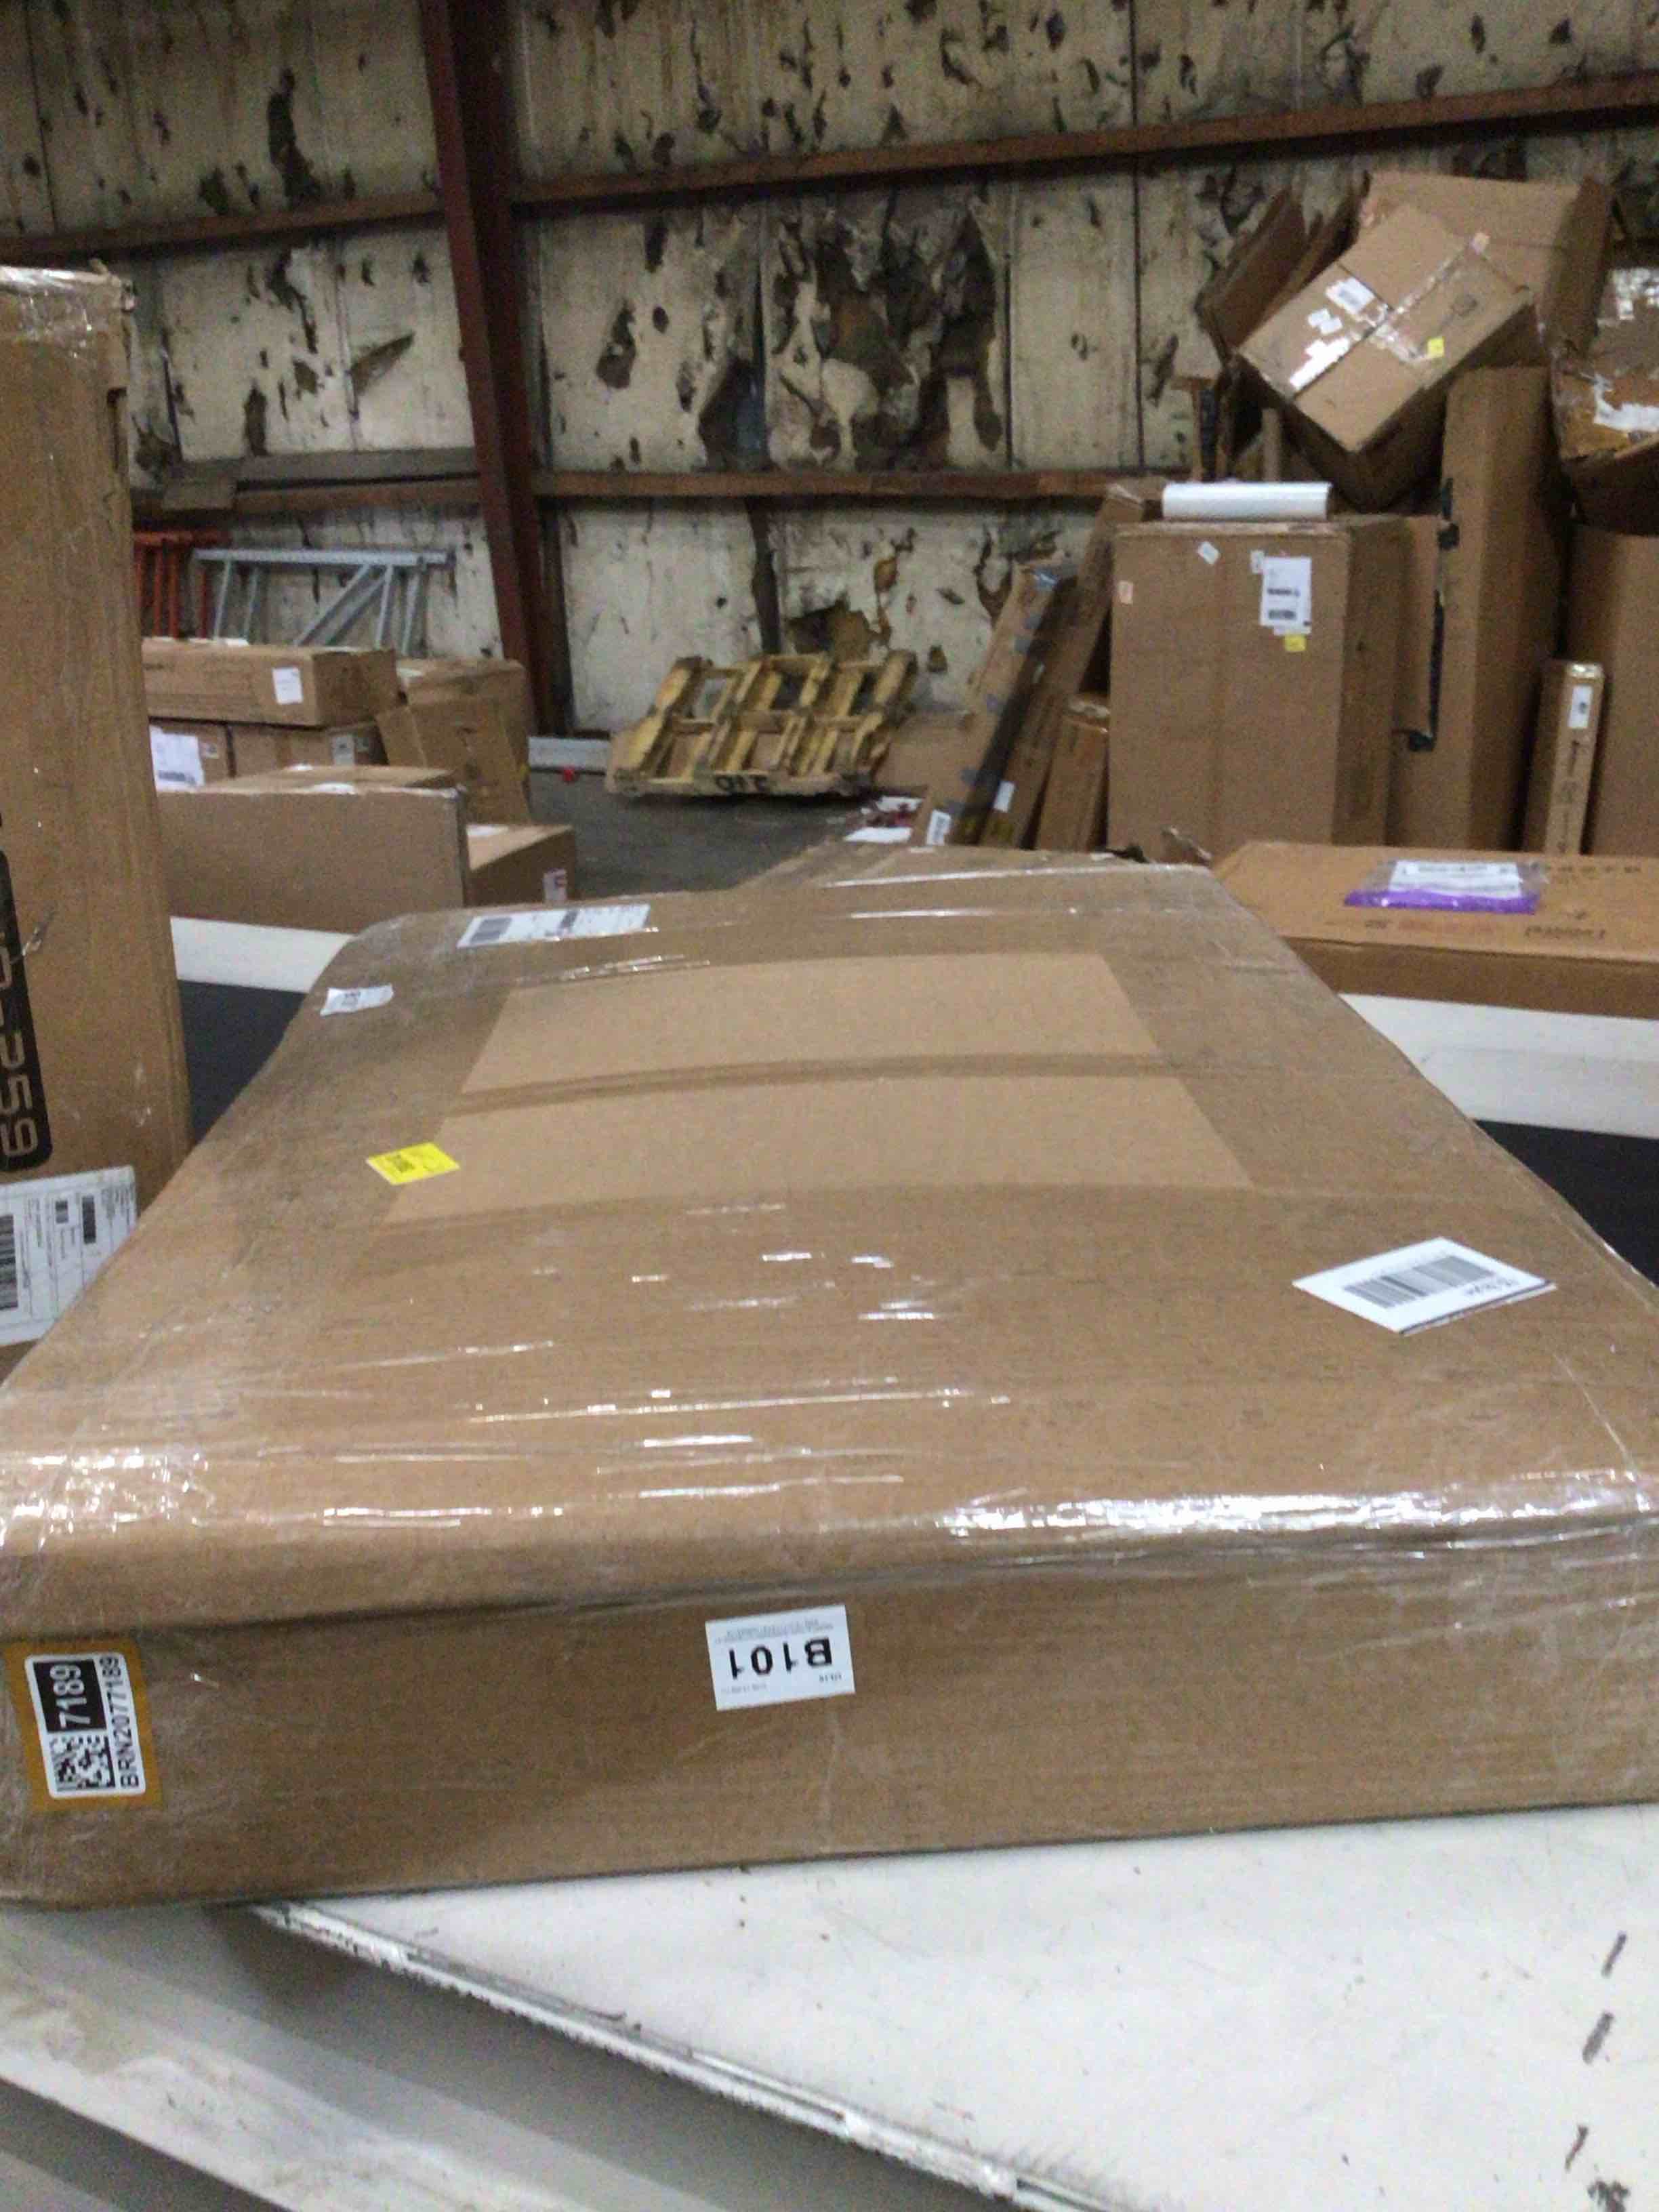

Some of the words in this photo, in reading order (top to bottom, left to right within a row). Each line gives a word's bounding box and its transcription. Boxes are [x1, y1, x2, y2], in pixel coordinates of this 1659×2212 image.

[729, 1637, 832, 1680] B101
[50, 1664, 90, 1728] 7189
[99, 1656, 139, 1788] BRN2077189
